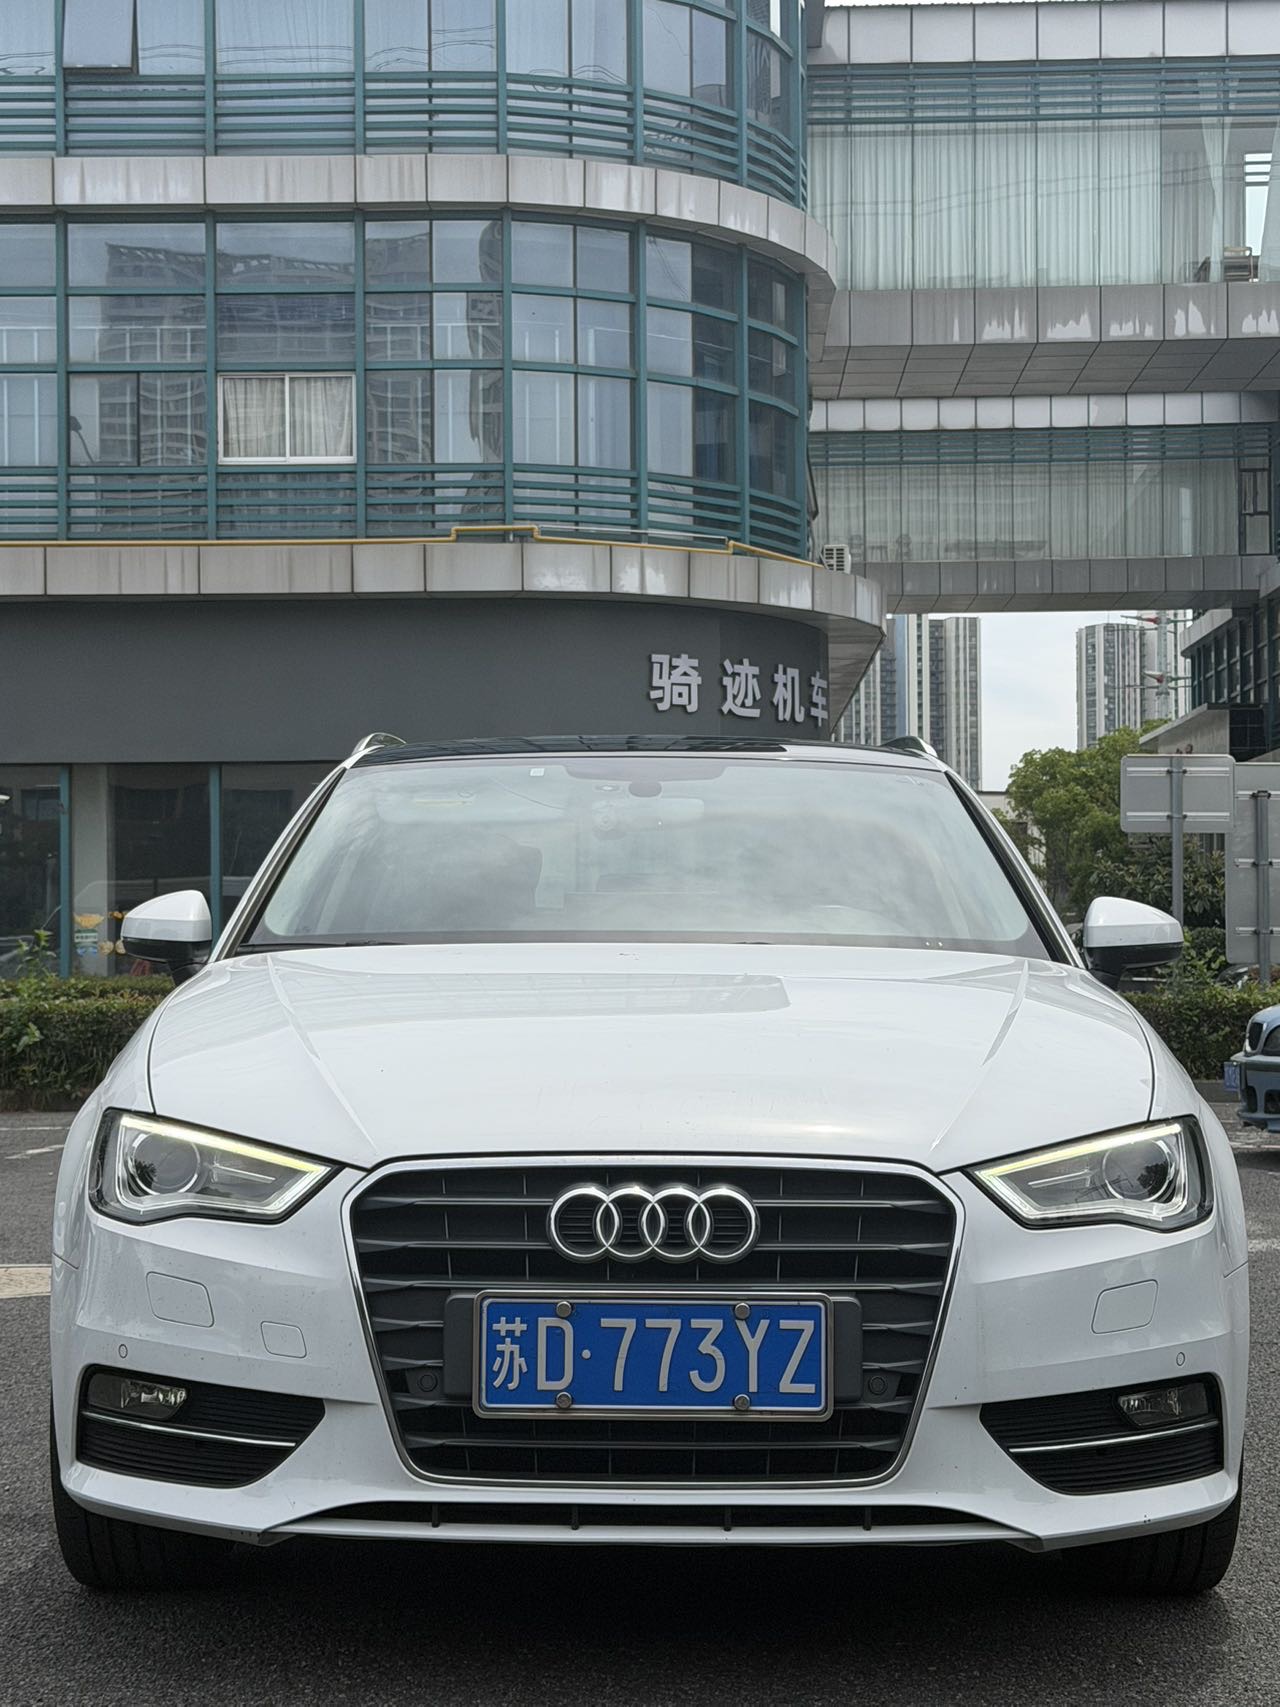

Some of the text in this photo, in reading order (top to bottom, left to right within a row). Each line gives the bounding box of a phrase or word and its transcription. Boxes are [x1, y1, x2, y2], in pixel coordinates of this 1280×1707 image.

[649, 653, 828, 727] 骑迹机车
[492, 1316, 817, 1394] 苏D·773YZ
